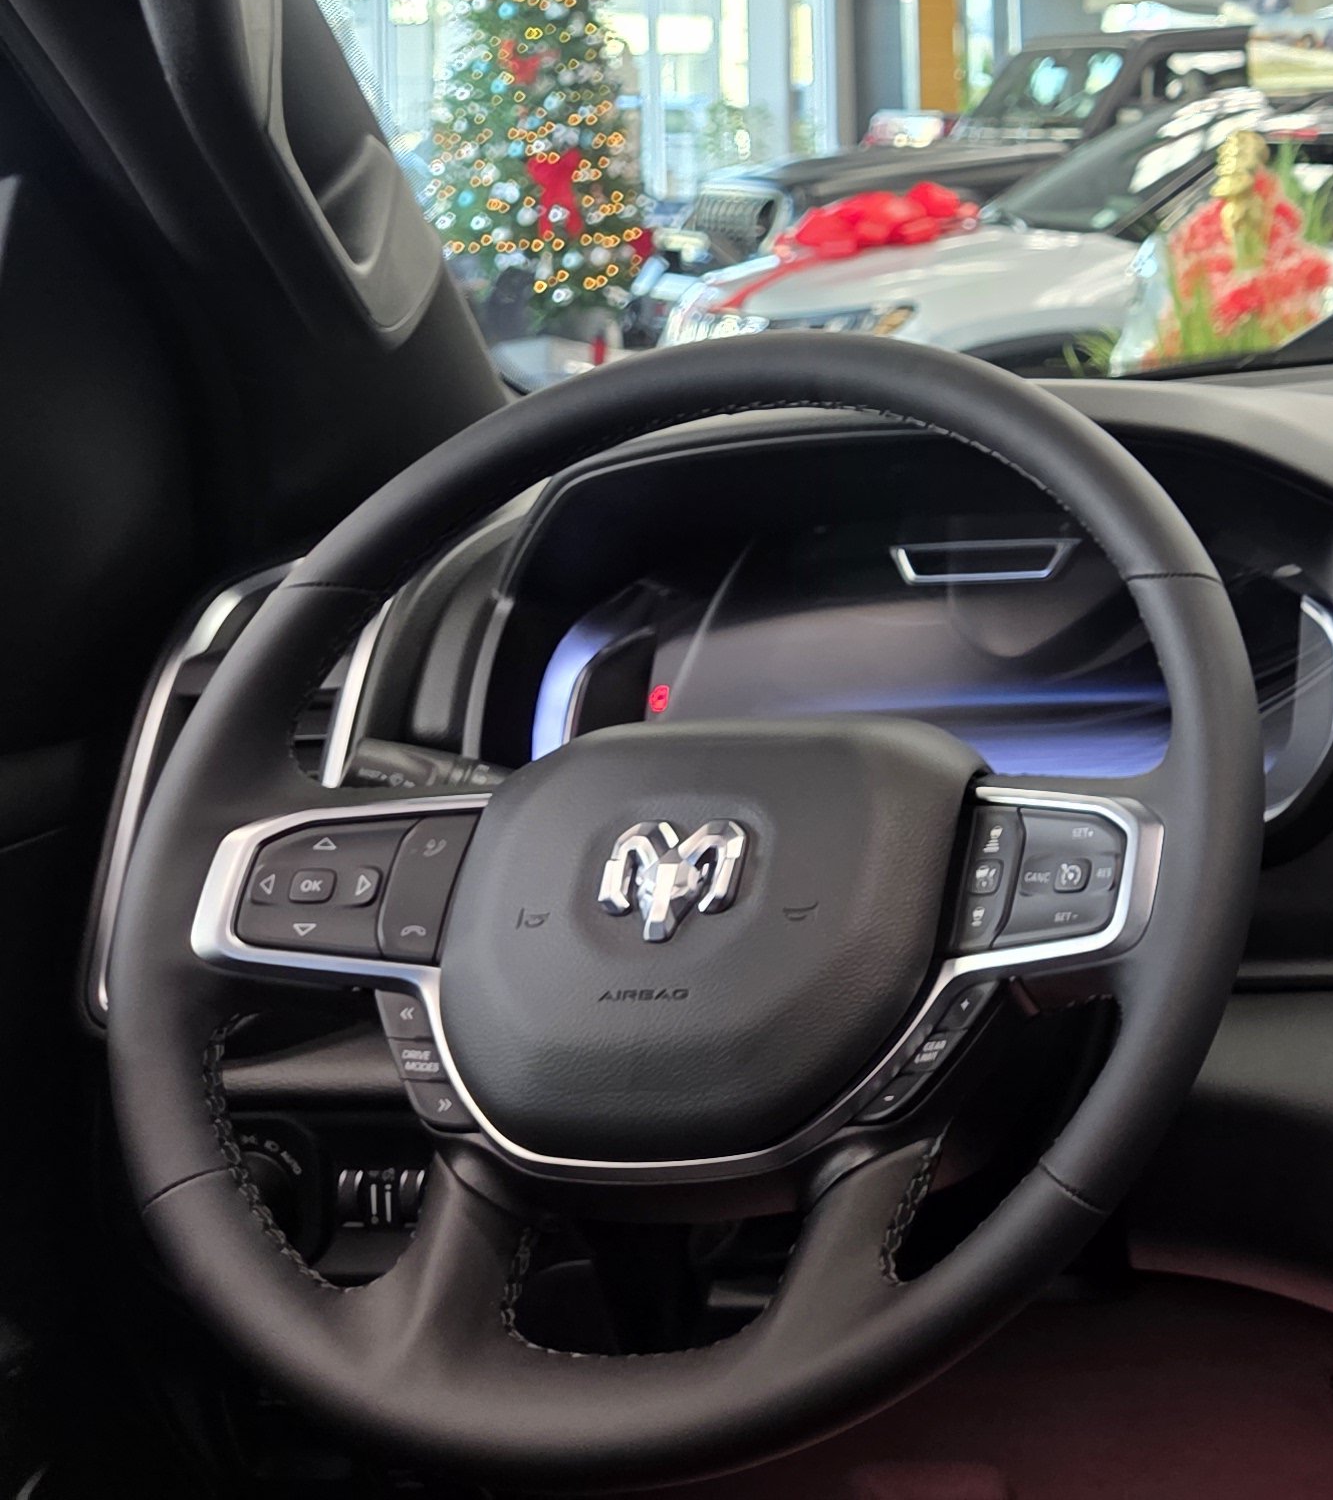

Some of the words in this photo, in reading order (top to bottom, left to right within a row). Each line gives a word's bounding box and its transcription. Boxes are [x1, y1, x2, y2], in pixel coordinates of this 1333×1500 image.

[300, 879, 324, 892] OK
[598, 987, 690, 1002] AIRBAG
[401, 1049, 431, 1061] DRIVE
[404, 1060, 440, 1073] MODES
